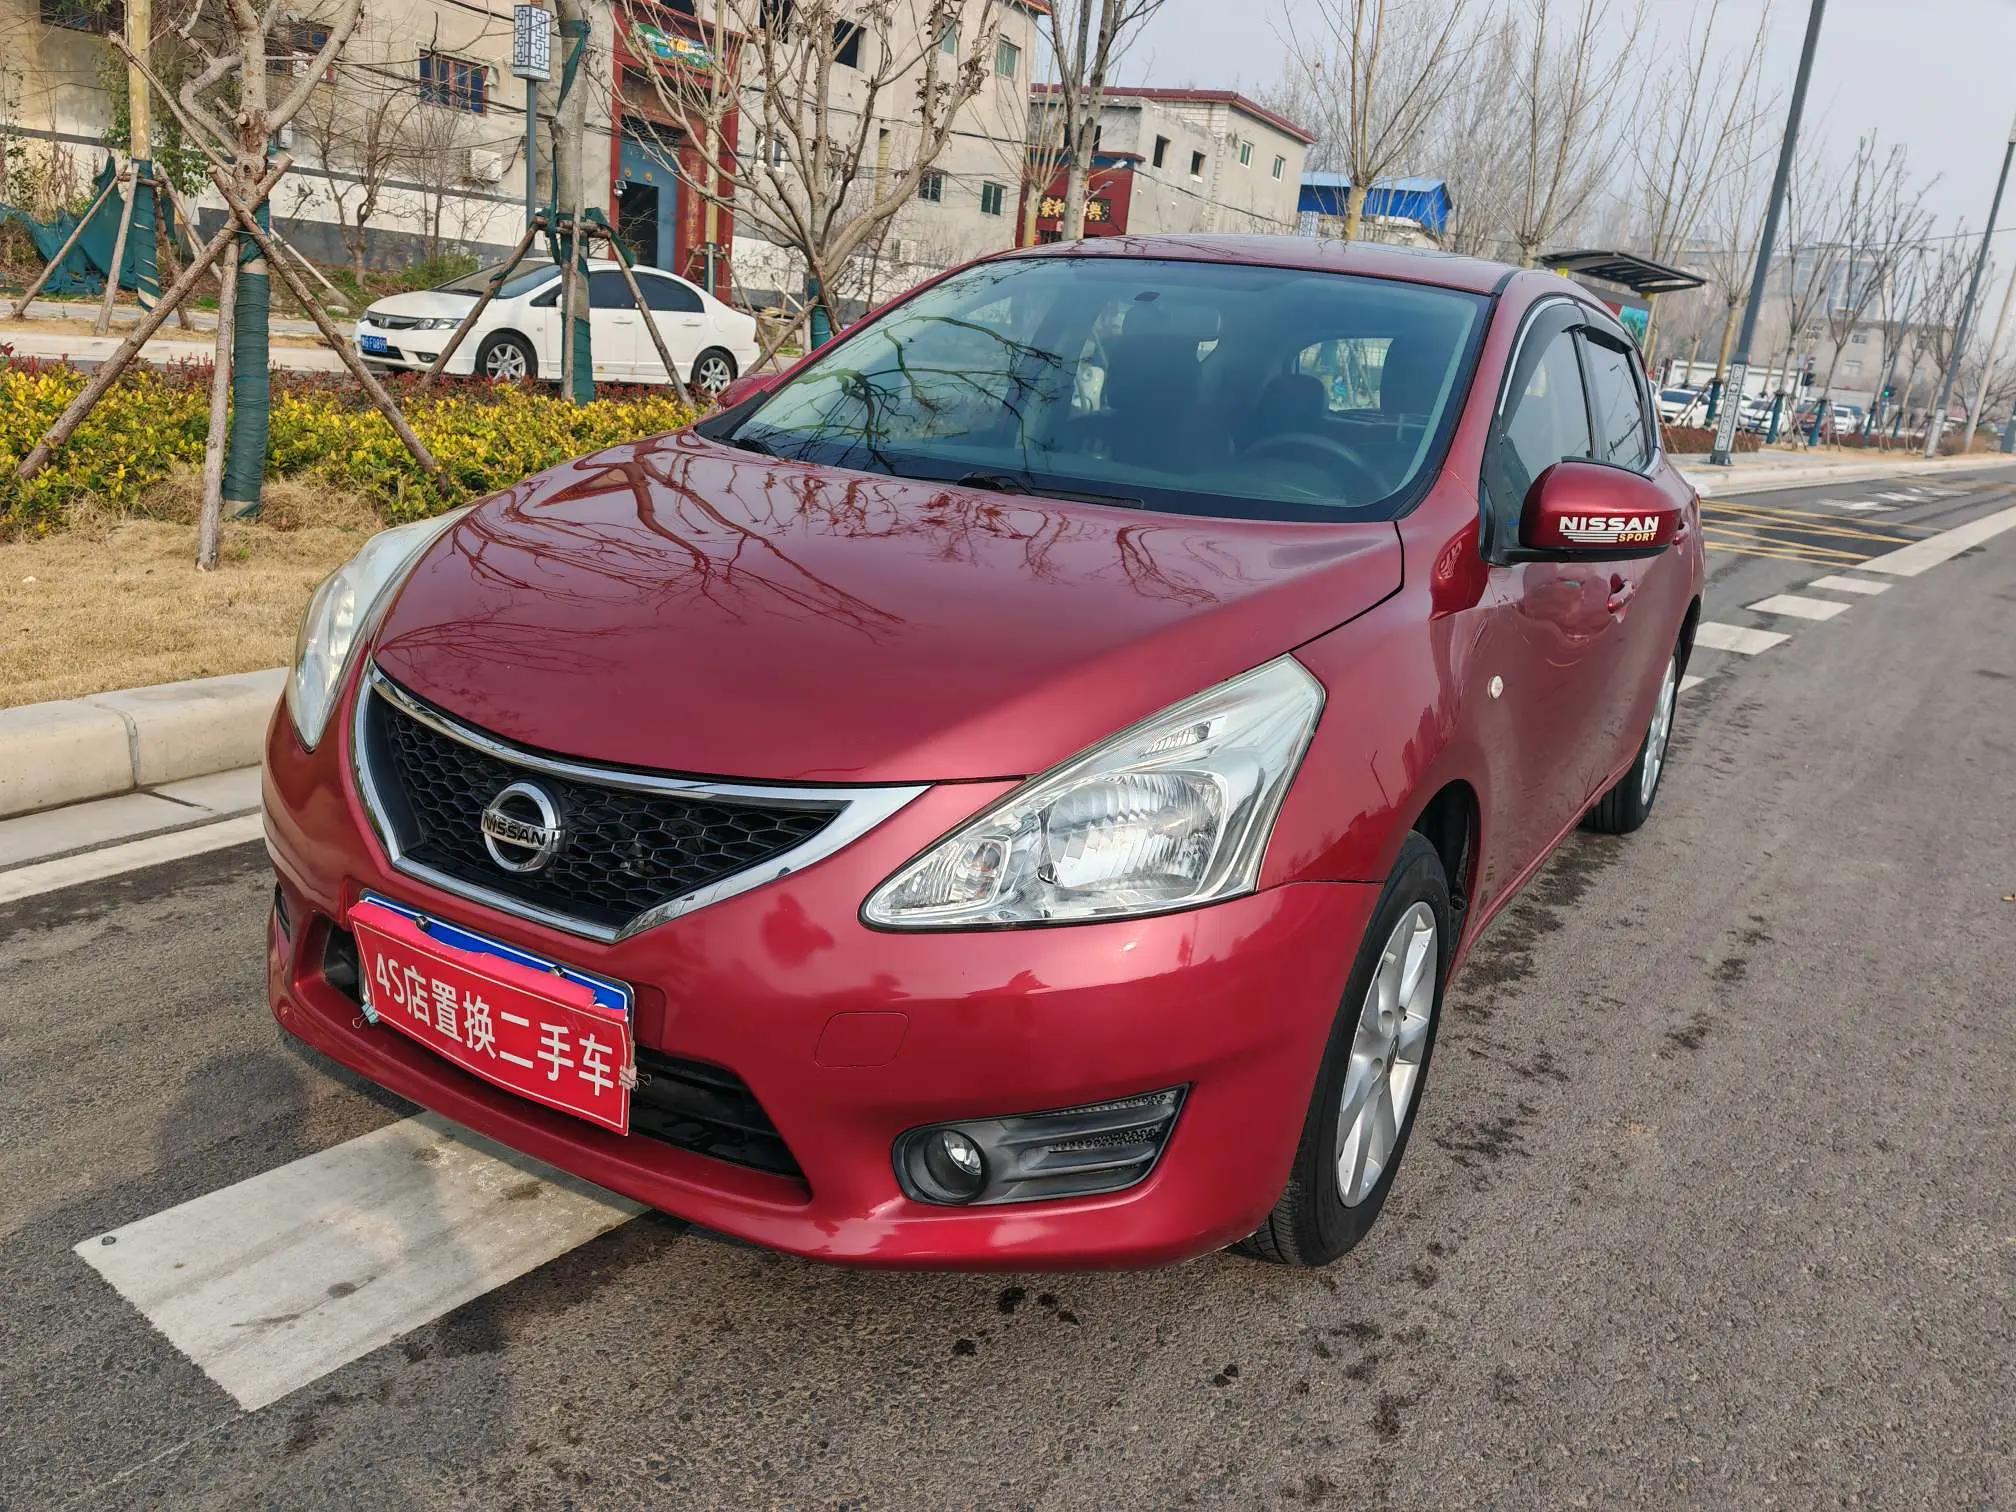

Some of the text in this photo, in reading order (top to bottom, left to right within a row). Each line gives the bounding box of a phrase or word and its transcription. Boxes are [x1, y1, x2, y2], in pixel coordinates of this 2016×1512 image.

[1560, 516, 1659, 531] NISSAN
[1618, 532, 1656, 542] SPORT
[483, 814, 547, 846] NISSAN
[375, 952, 614, 1097] 4S店置换二手车
